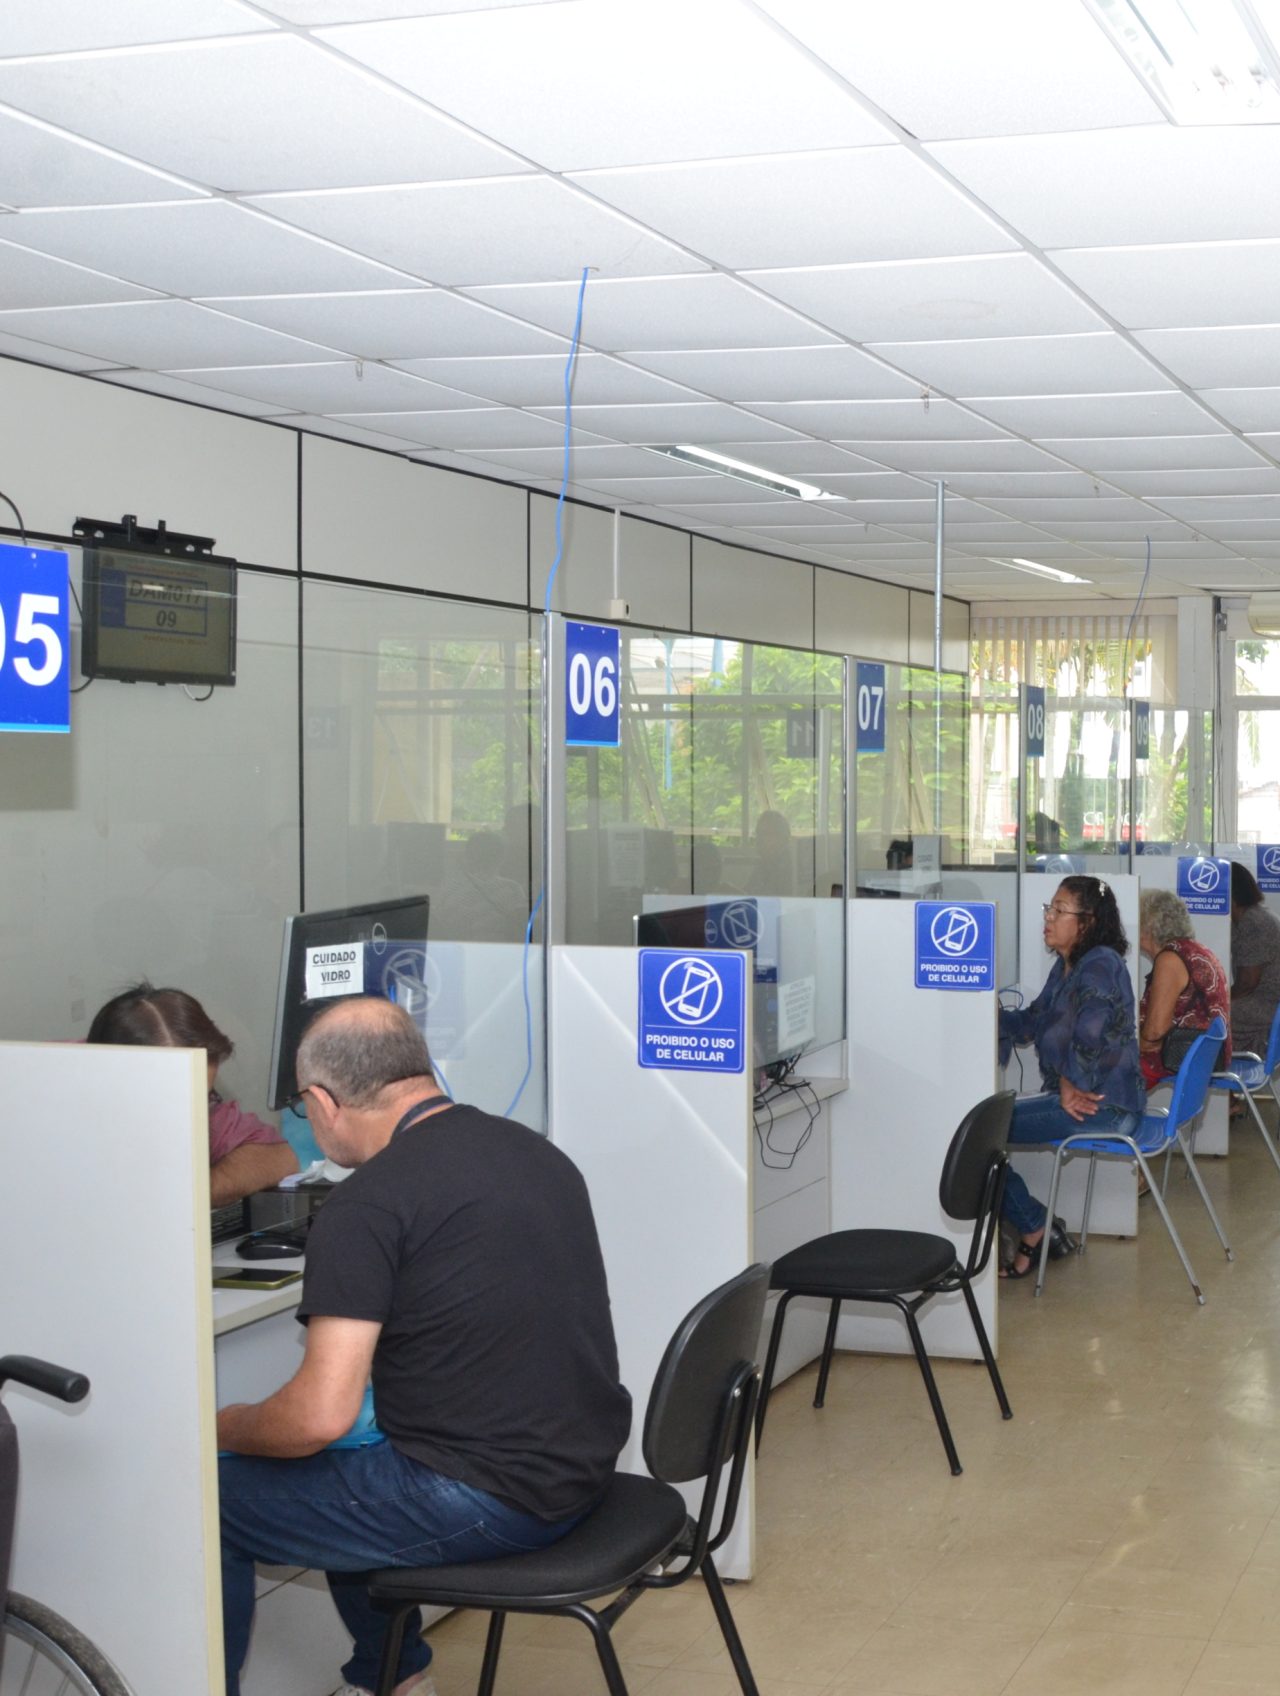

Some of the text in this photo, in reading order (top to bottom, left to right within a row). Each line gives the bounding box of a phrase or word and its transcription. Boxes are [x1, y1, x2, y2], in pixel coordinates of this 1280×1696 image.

[156, 609, 178, 628] 09
[0, 592, 63, 687] 5
[569, 652, 616, 717] 06
[858, 684, 883, 730] 07
[1027, 703, 1044, 740] 08
[1136, 715, 1149, 745] 09
[312, 951, 357, 964] CUIDADO
[321, 970, 351, 982] VIDRO
[920, 963, 988, 974] PROIBIDO O USO
[928, 974, 979, 983] DE CELULAR
[646, 1034, 735, 1049] PROIBIDO O USO
[656, 1048, 725, 1062] DE CELULAR
